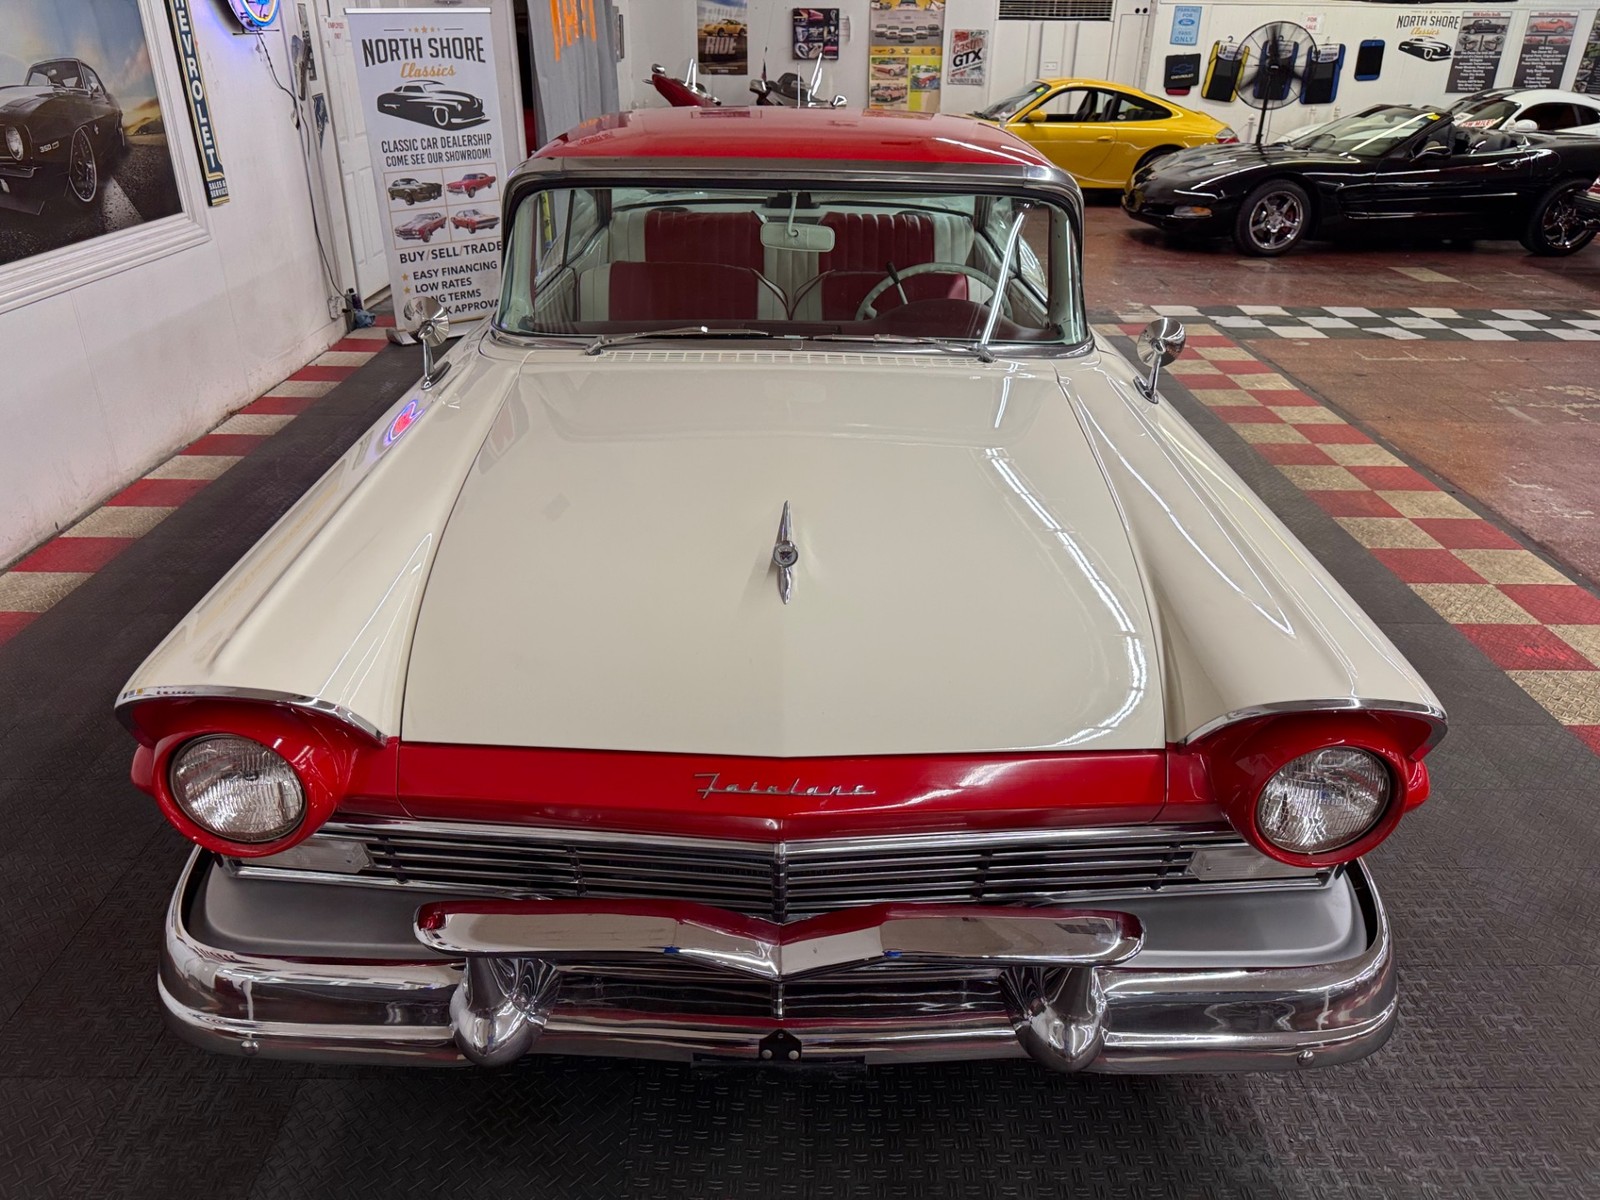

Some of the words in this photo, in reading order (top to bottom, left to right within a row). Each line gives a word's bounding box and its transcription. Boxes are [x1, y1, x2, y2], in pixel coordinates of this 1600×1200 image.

[1396, 15, 1428, 29] NORTH
[1430, 15, 1460, 30] SHORE
[361, 38, 423, 68] NORTH
[427, 36, 486, 63] SHORE
[704, 37, 737, 55] RIDE
[953, 48, 983, 67] GTX
[400, 62, 456, 78] Classics
[175, 0, 216, 169] EVROLET
[381, 138, 419, 154] CLASSIC
[420, 136, 438, 151] CAR
[440, 133, 492, 149] DEALERSHIP
[385, 154, 410, 168] COME
[410, 153, 426, 166] SEE
[427, 151, 444, 164] OUR
[444, 148, 492, 163] SHOWROOM!
[413, 268, 440, 281] EASY
[441, 260, 498, 277] FINANCING
[415, 281, 440, 294] LOW
[441, 276, 473, 291] RATES
[448, 288, 482, 302] TERMS
[454, 298, 500, 315] APPROVA
[694, 772, 877, 800] Fairlane
